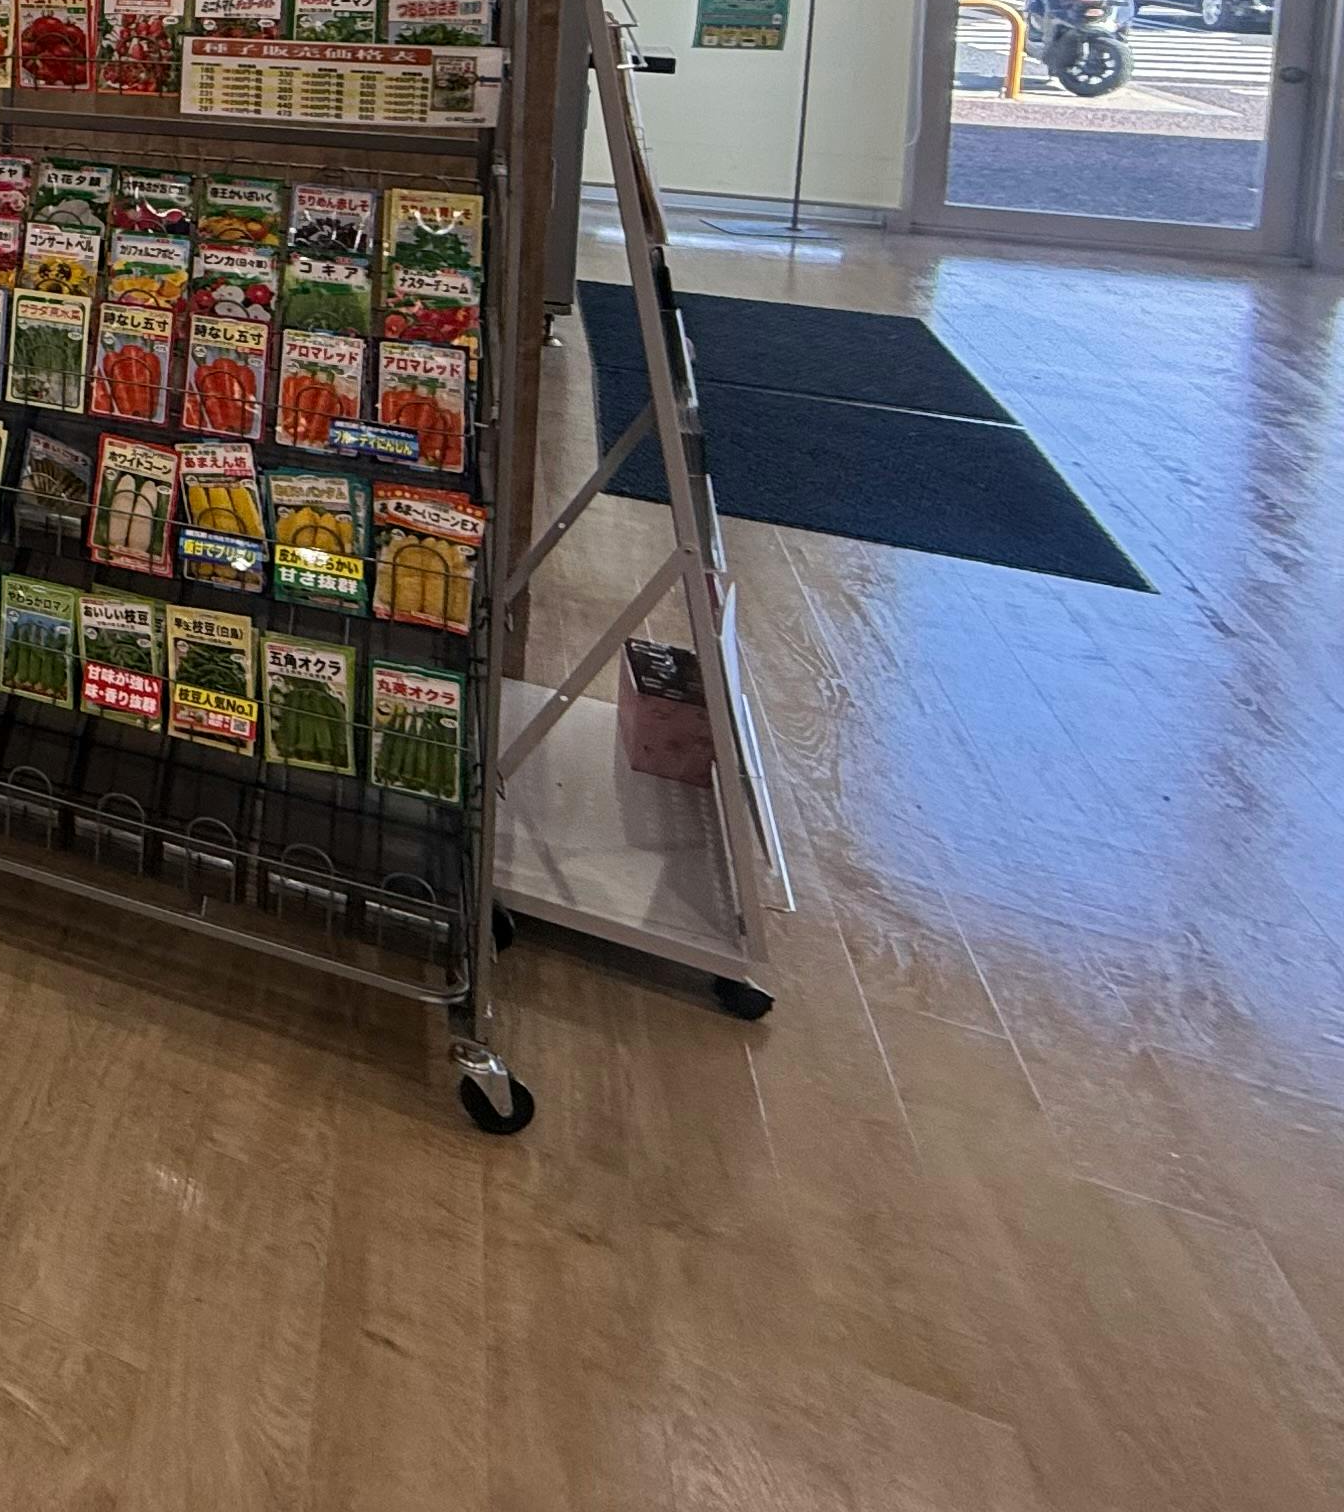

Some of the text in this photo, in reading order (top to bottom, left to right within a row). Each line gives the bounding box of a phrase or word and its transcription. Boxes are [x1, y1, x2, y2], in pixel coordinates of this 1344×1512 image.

[298, 195, 369, 213] ちりめん赤しそ
[299, 262, 358, 279] コキア
[286, 343, 359, 365] アロマレッド
[383, 357, 461, 376] アロマレッド
[108, 451, 172, 474] ホワイトコーン
[279, 568, 358, 594] 甘さ抜群
[83, 606, 149, 626] おいしい枝豆
[269, 651, 341, 676] 五角オクラ
[88, 665, 158, 693] 甘味が強い
